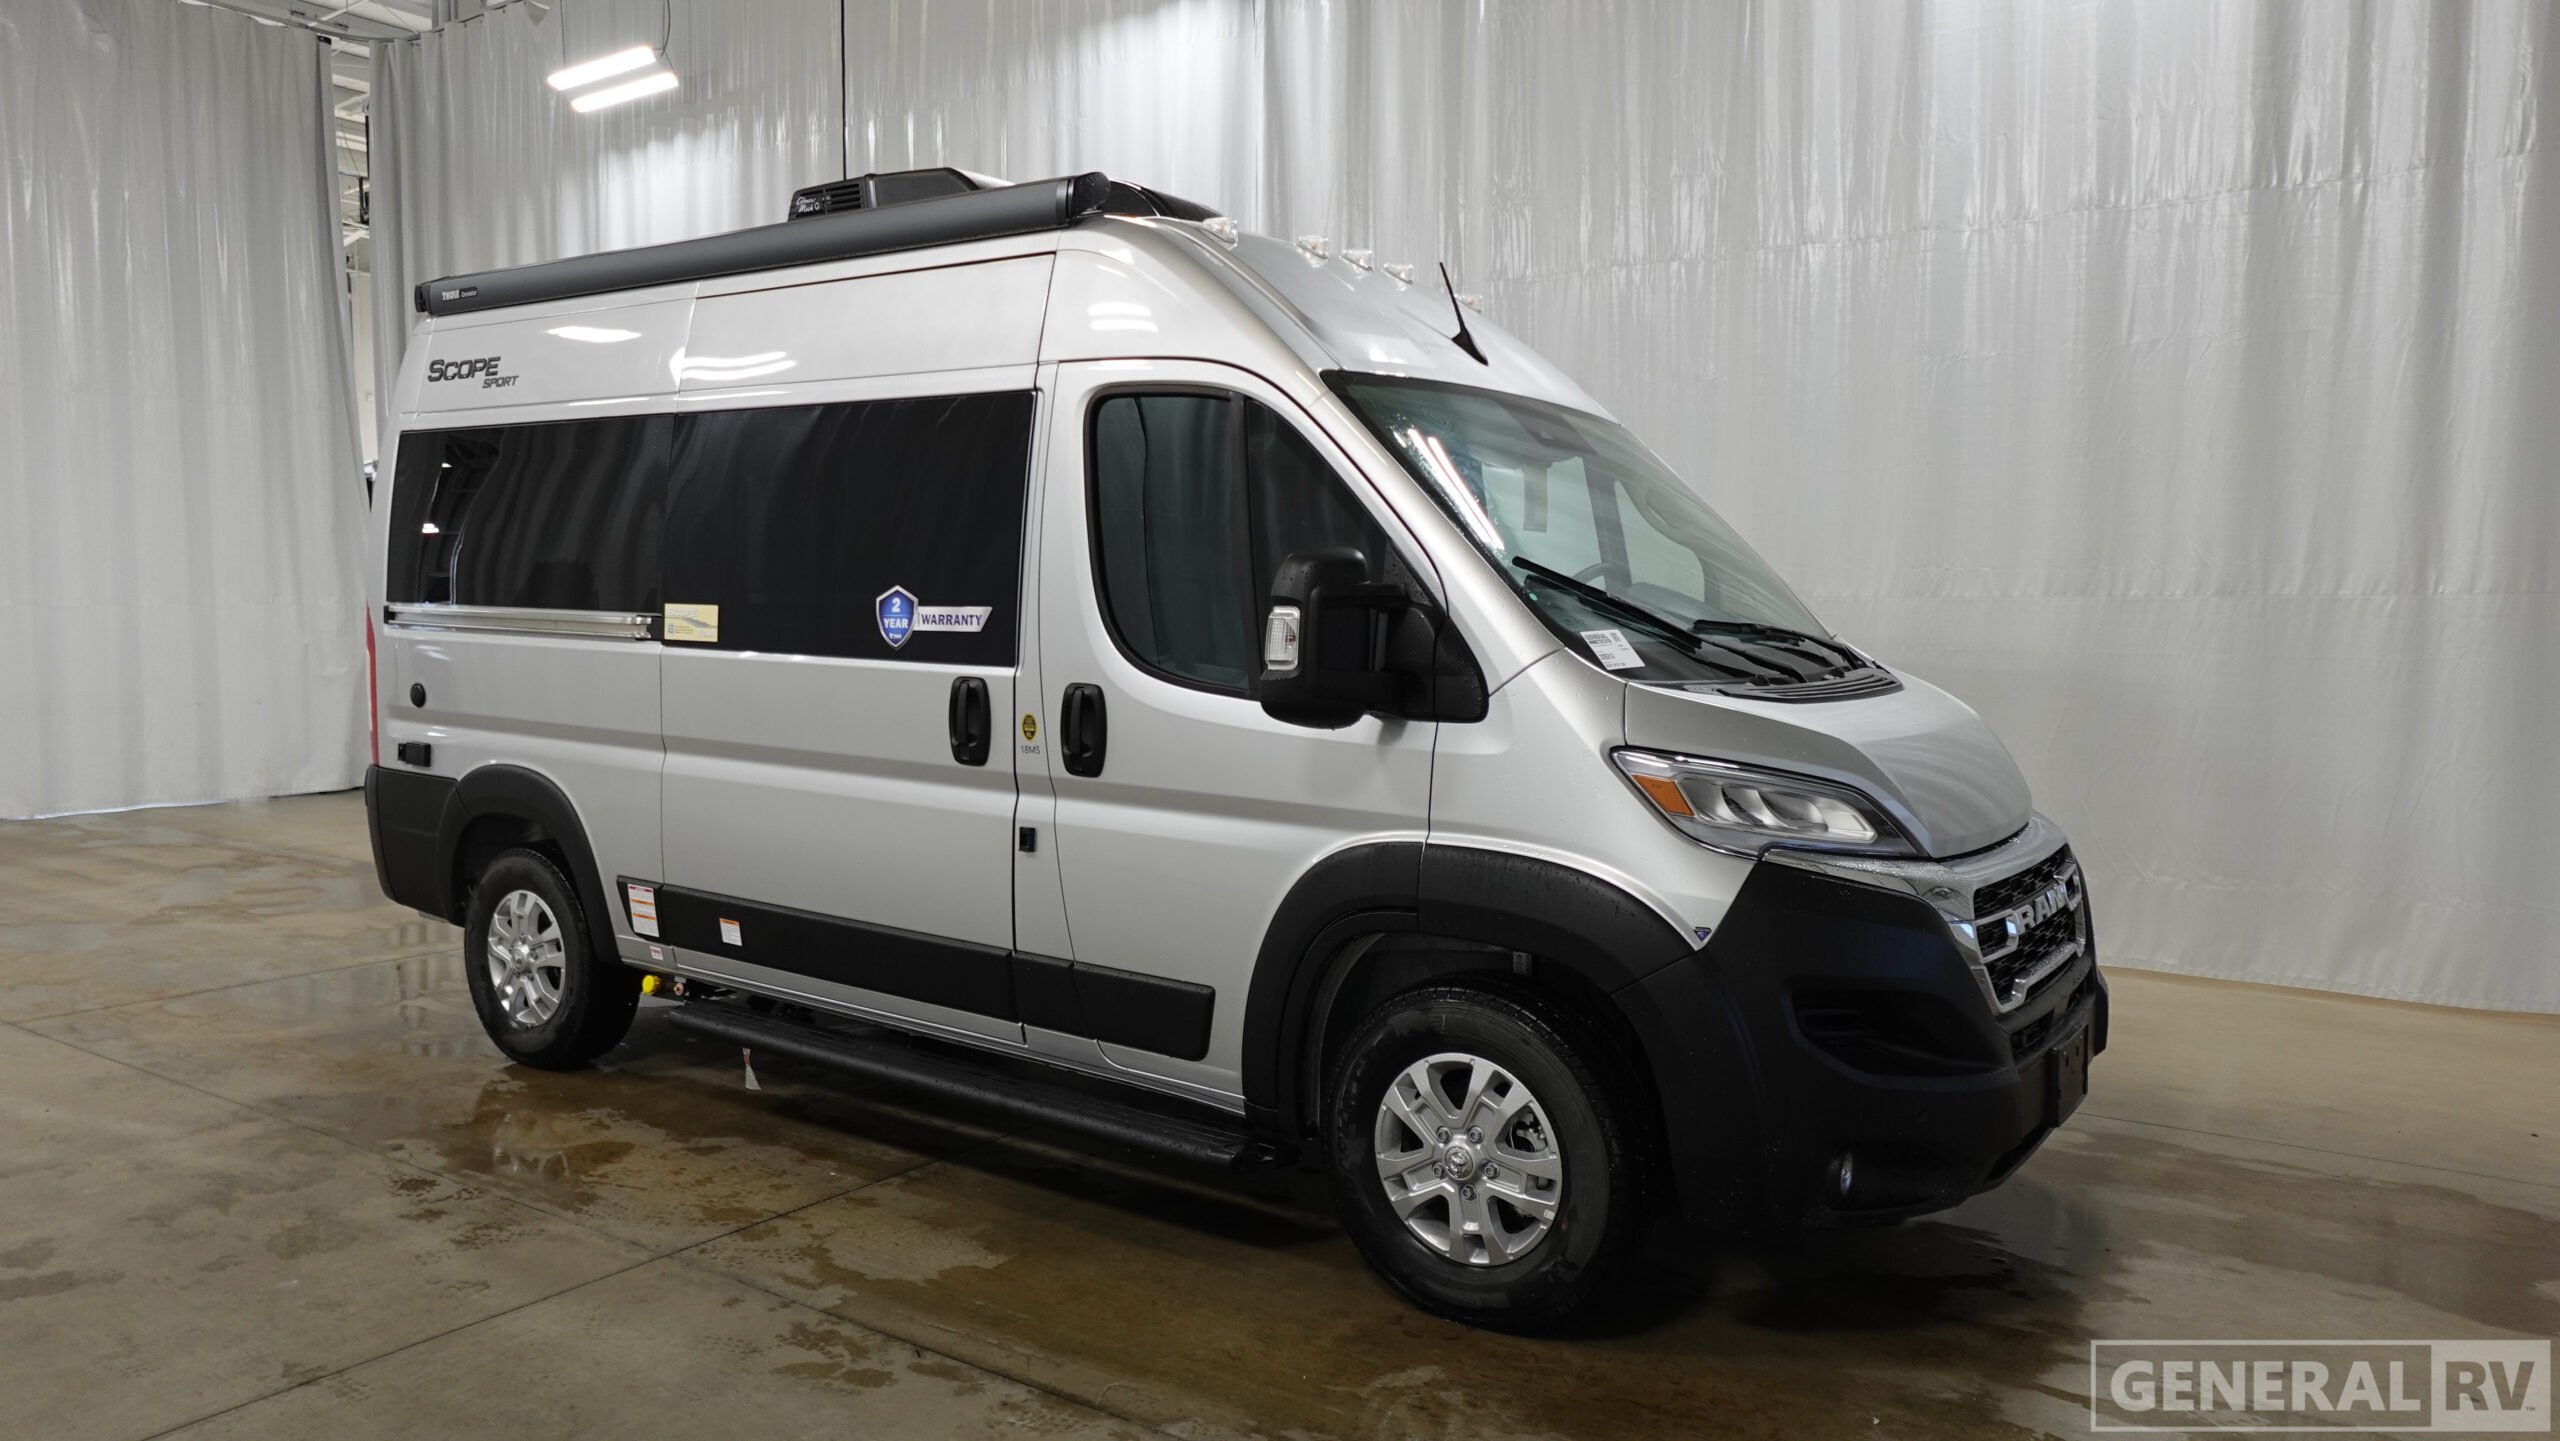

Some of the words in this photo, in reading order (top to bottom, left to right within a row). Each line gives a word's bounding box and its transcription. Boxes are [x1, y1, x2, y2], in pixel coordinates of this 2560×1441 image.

[442, 289, 460, 301] THULE
[428, 356, 501, 382] SCOPE
[482, 375, 519, 389] SPORT
[891, 597, 901, 613] 2
[884, 618, 909, 629] YEAR
[921, 614, 982, 626] WARRANTY
[2013, 883, 2067, 935] RAM
